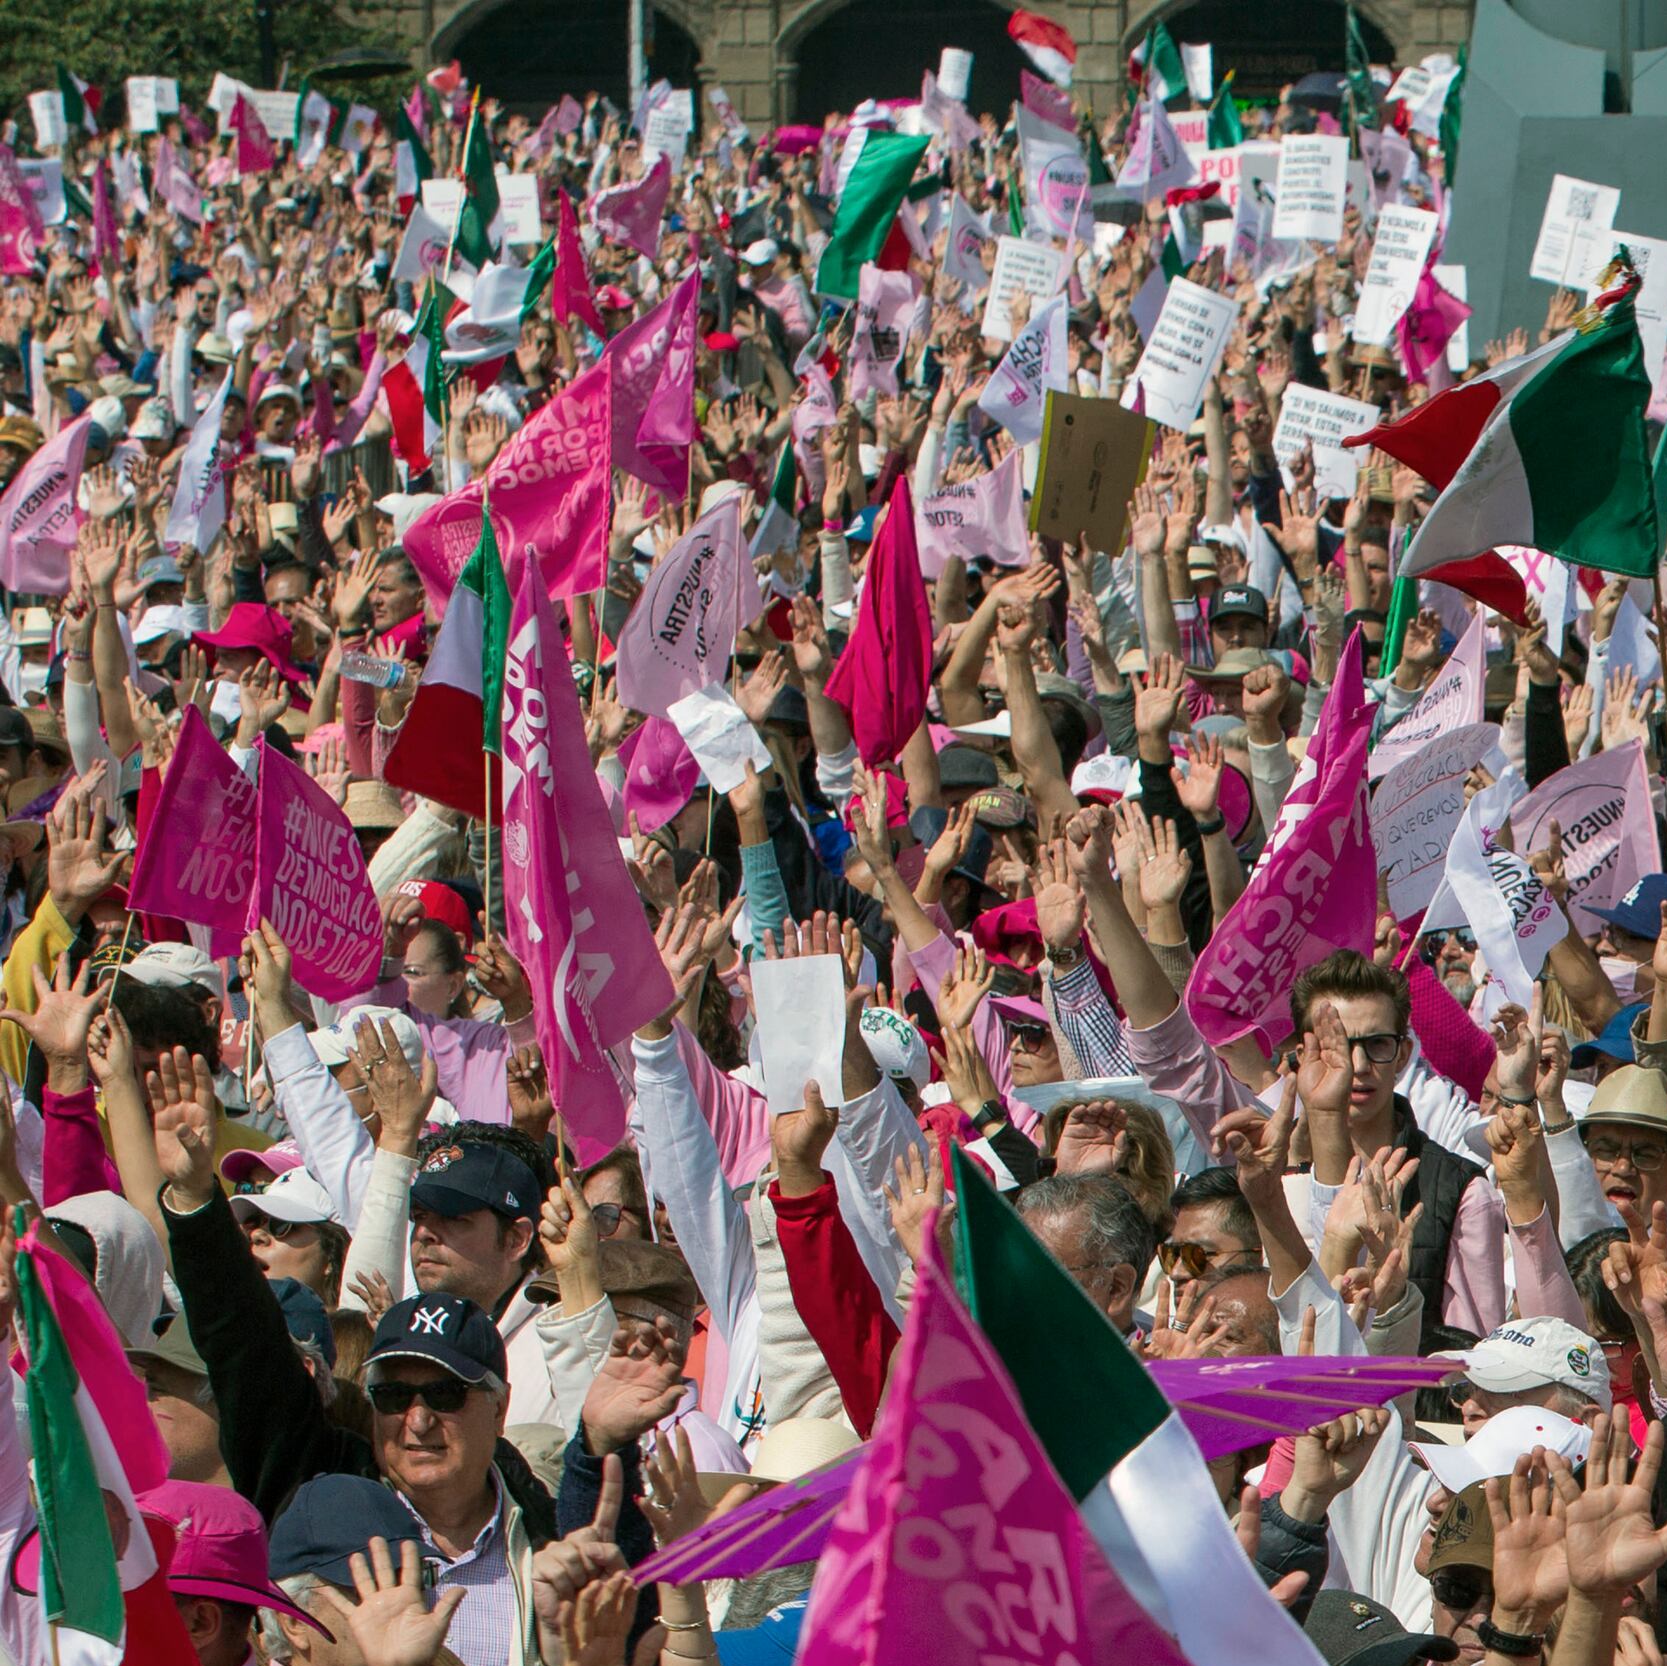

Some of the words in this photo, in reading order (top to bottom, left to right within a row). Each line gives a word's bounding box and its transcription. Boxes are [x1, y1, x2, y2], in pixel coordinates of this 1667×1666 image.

[284, 796, 364, 888] #NUES
[1389, 793, 1461, 846] QUEREMOS
[270, 884, 381, 986] NOSETOCA
[275, 843, 384, 941] DEMOCRACI
[409, 1307, 450, 1335] NY
